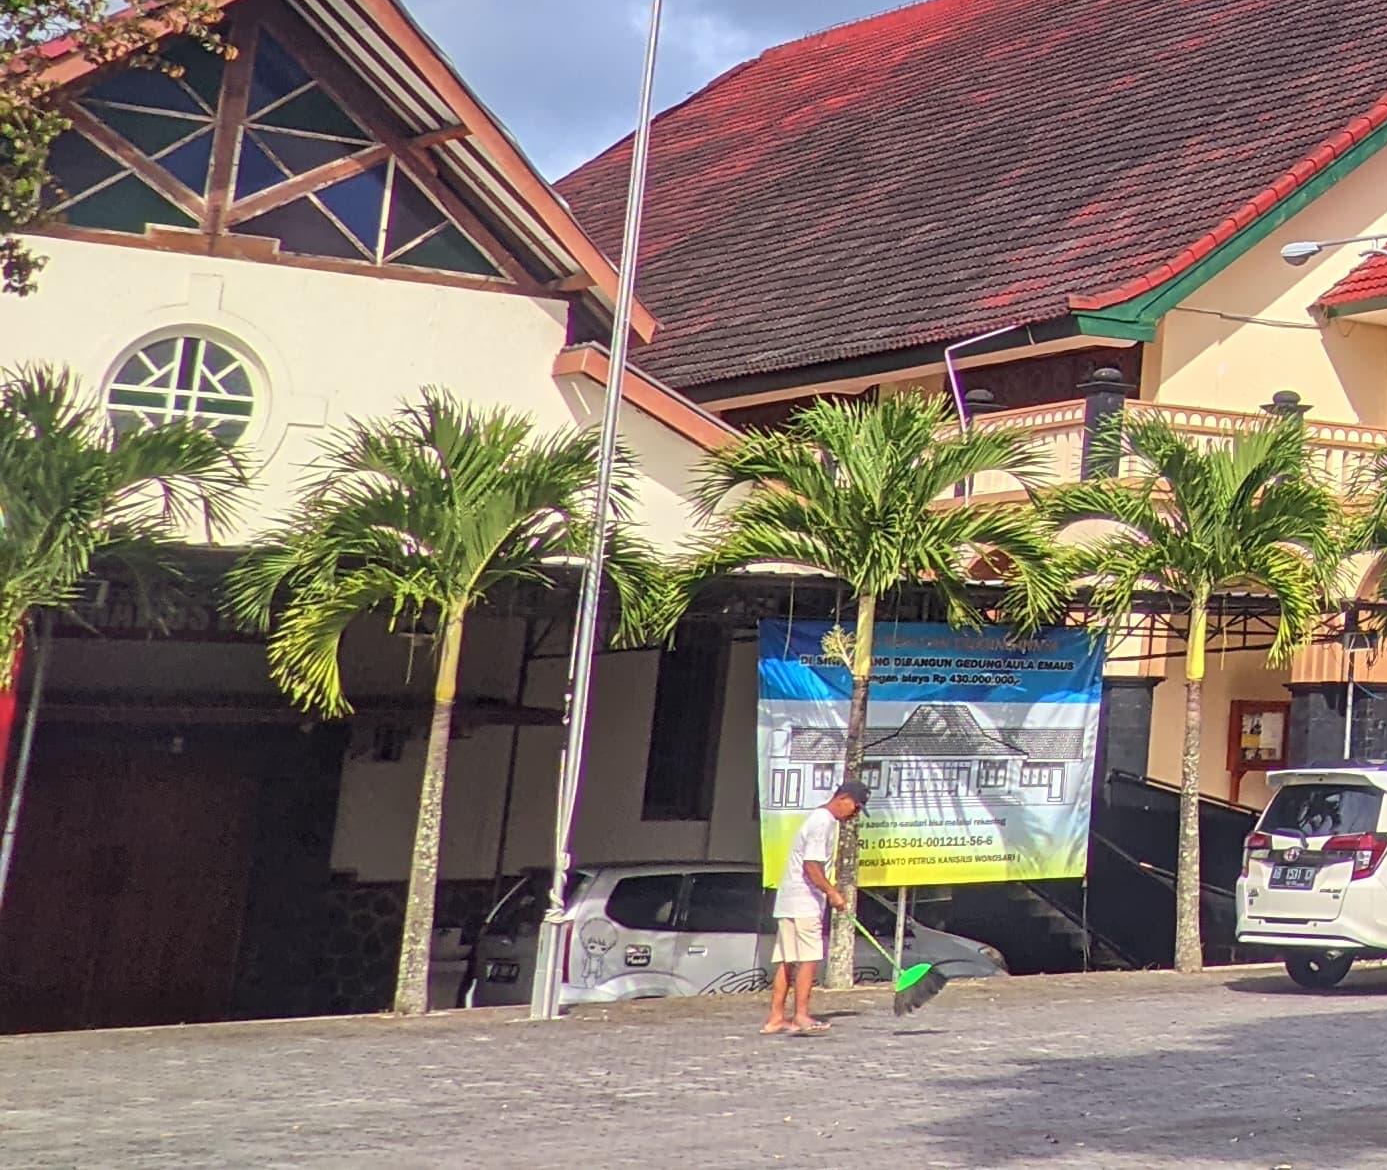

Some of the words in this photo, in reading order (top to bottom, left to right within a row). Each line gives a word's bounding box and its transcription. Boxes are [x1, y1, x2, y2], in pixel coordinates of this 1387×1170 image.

[800, 656, 812, 666] DI
[894, 657, 952, 668] DIBANGUN
[955, 658, 1002, 669] GEDUNG
[1006, 659, 1034, 670] AULA
[1038, 660, 1074, 670] EMAUS
[902, 674, 930, 685] biaya
[933, 674, 947, 685] Rp
[857, 839, 869, 849] RI
[878, 835, 993, 849] 0153-01-001211-56-6
[880, 857, 906, 867] SANTO
[908, 856, 936, 865] PETRUS
